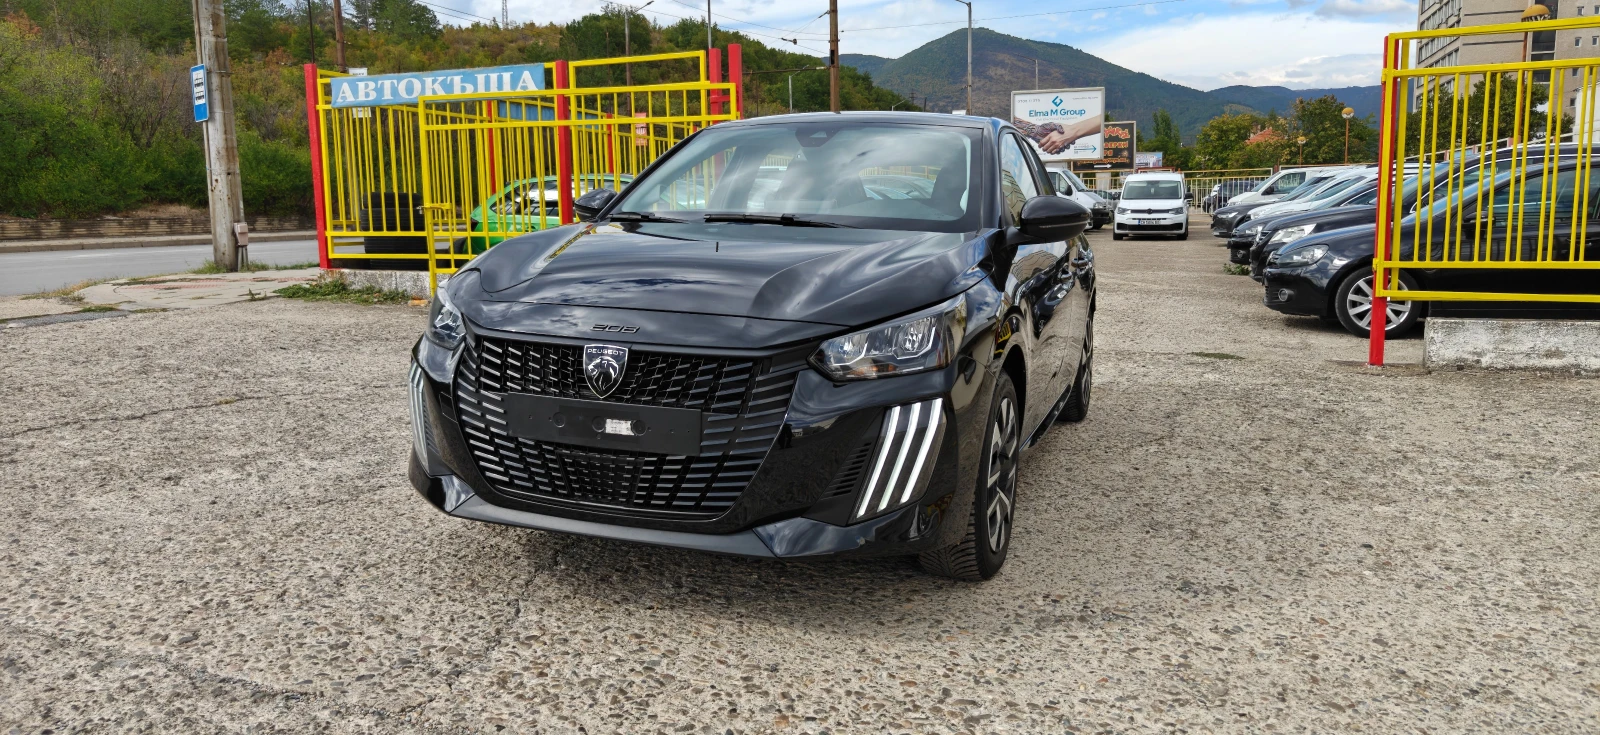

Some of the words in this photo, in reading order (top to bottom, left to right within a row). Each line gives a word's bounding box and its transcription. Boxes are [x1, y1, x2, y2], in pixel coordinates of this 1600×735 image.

[1028, 109, 1049, 118] Elma
[1050, 108, 1058, 117] M
[1059, 108, 1086, 118] Group
[590, 324, 640, 334] 208
[587, 348, 625, 356] PEUGEOT
